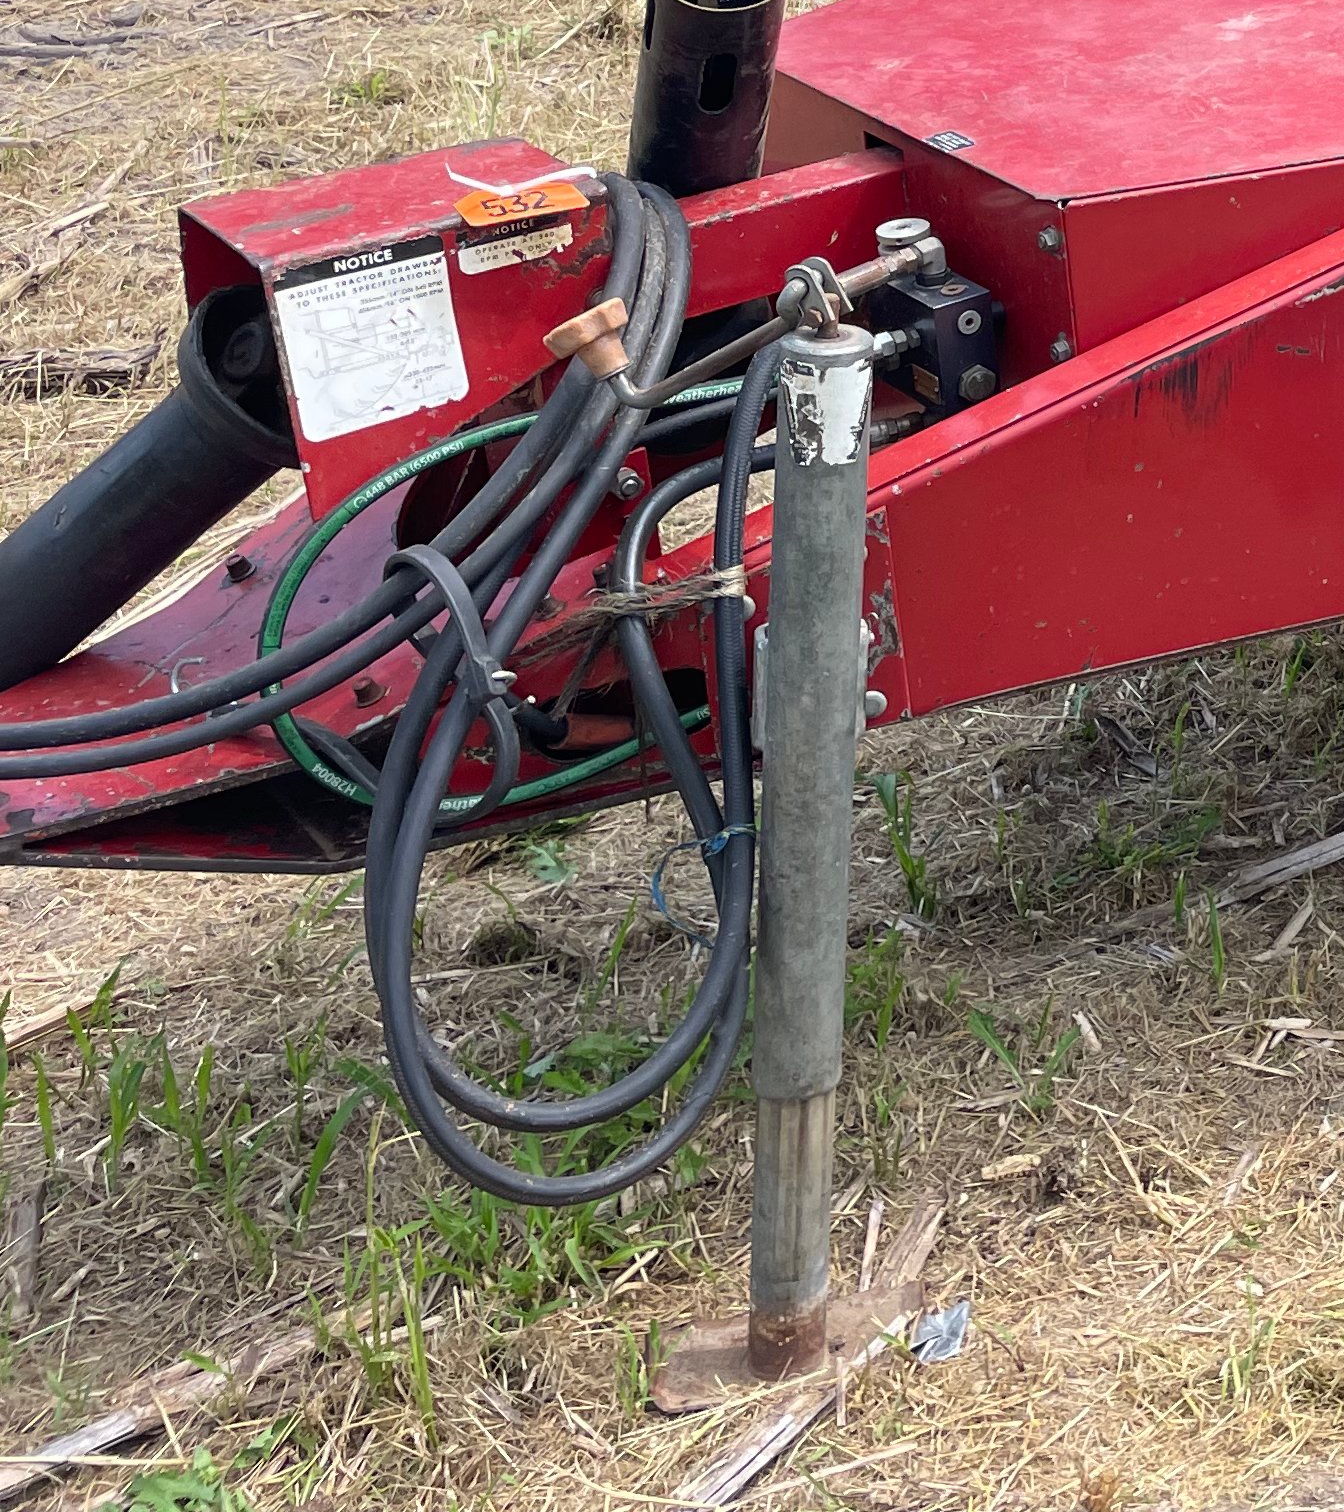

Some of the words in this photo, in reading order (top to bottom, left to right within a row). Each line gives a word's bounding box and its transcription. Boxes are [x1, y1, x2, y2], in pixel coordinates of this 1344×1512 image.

[480, 191, 555, 218] 532
[334, 248, 394, 273] NOTICE
[475, 241, 516, 256] OPERATE
[289, 285, 329, 301] ADJUST
[336, 272, 384, 289] TRACTOR
[296, 299, 310, 309] TO
[316, 291, 347, 304] THESE
[352, 268, 442, 295] SPECIFICATIONS:
[365, 481, 386, 499] 448
[385, 467, 410, 486] BAR
[410, 451, 441, 473] (6500
[442, 440, 464, 457] PSI)
[312, 762, 357, 798] H28004
